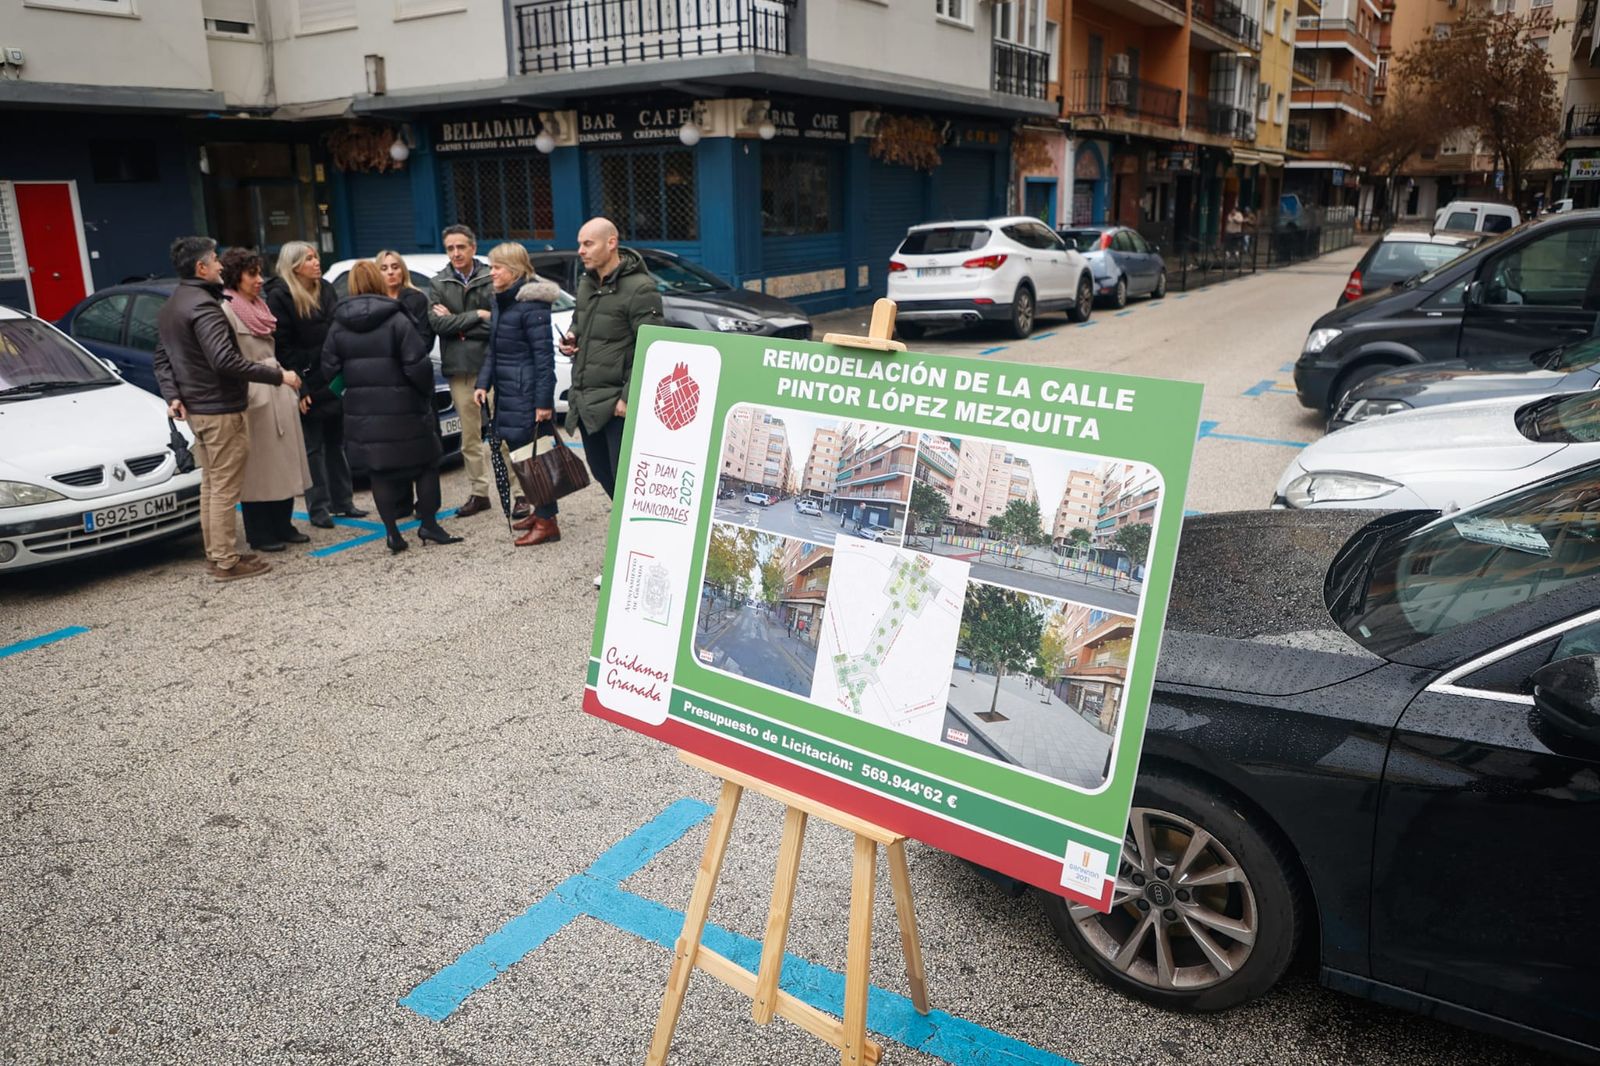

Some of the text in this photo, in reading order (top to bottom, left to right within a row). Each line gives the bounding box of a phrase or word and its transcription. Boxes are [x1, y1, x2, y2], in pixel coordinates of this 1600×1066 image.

[443, 118, 536, 141] BELLADAMA
[582, 113, 616, 130] BAR
[772, 110, 839, 129] BAR CAFE
[763, 348, 1136, 412] REMODELACIÓN DE LA CALLE
[777, 377, 1101, 440] PINTOR LÓPEZ MEZQUITA
[634, 461, 650, 496] 2024
[654, 463, 678, 479] PLAN
[649, 483, 678, 500] OBRAS
[680, 470, 696, 506] 2027
[95, 497, 176, 527] 6925 CMM
[632, 500, 689, 523] MUNICIPALES
[606, 646, 669, 683] Cuidamos
[606, 669, 662, 702] Granada
[683, 700, 958, 809] Presupuesto de Licitación: 569.944'62 €
